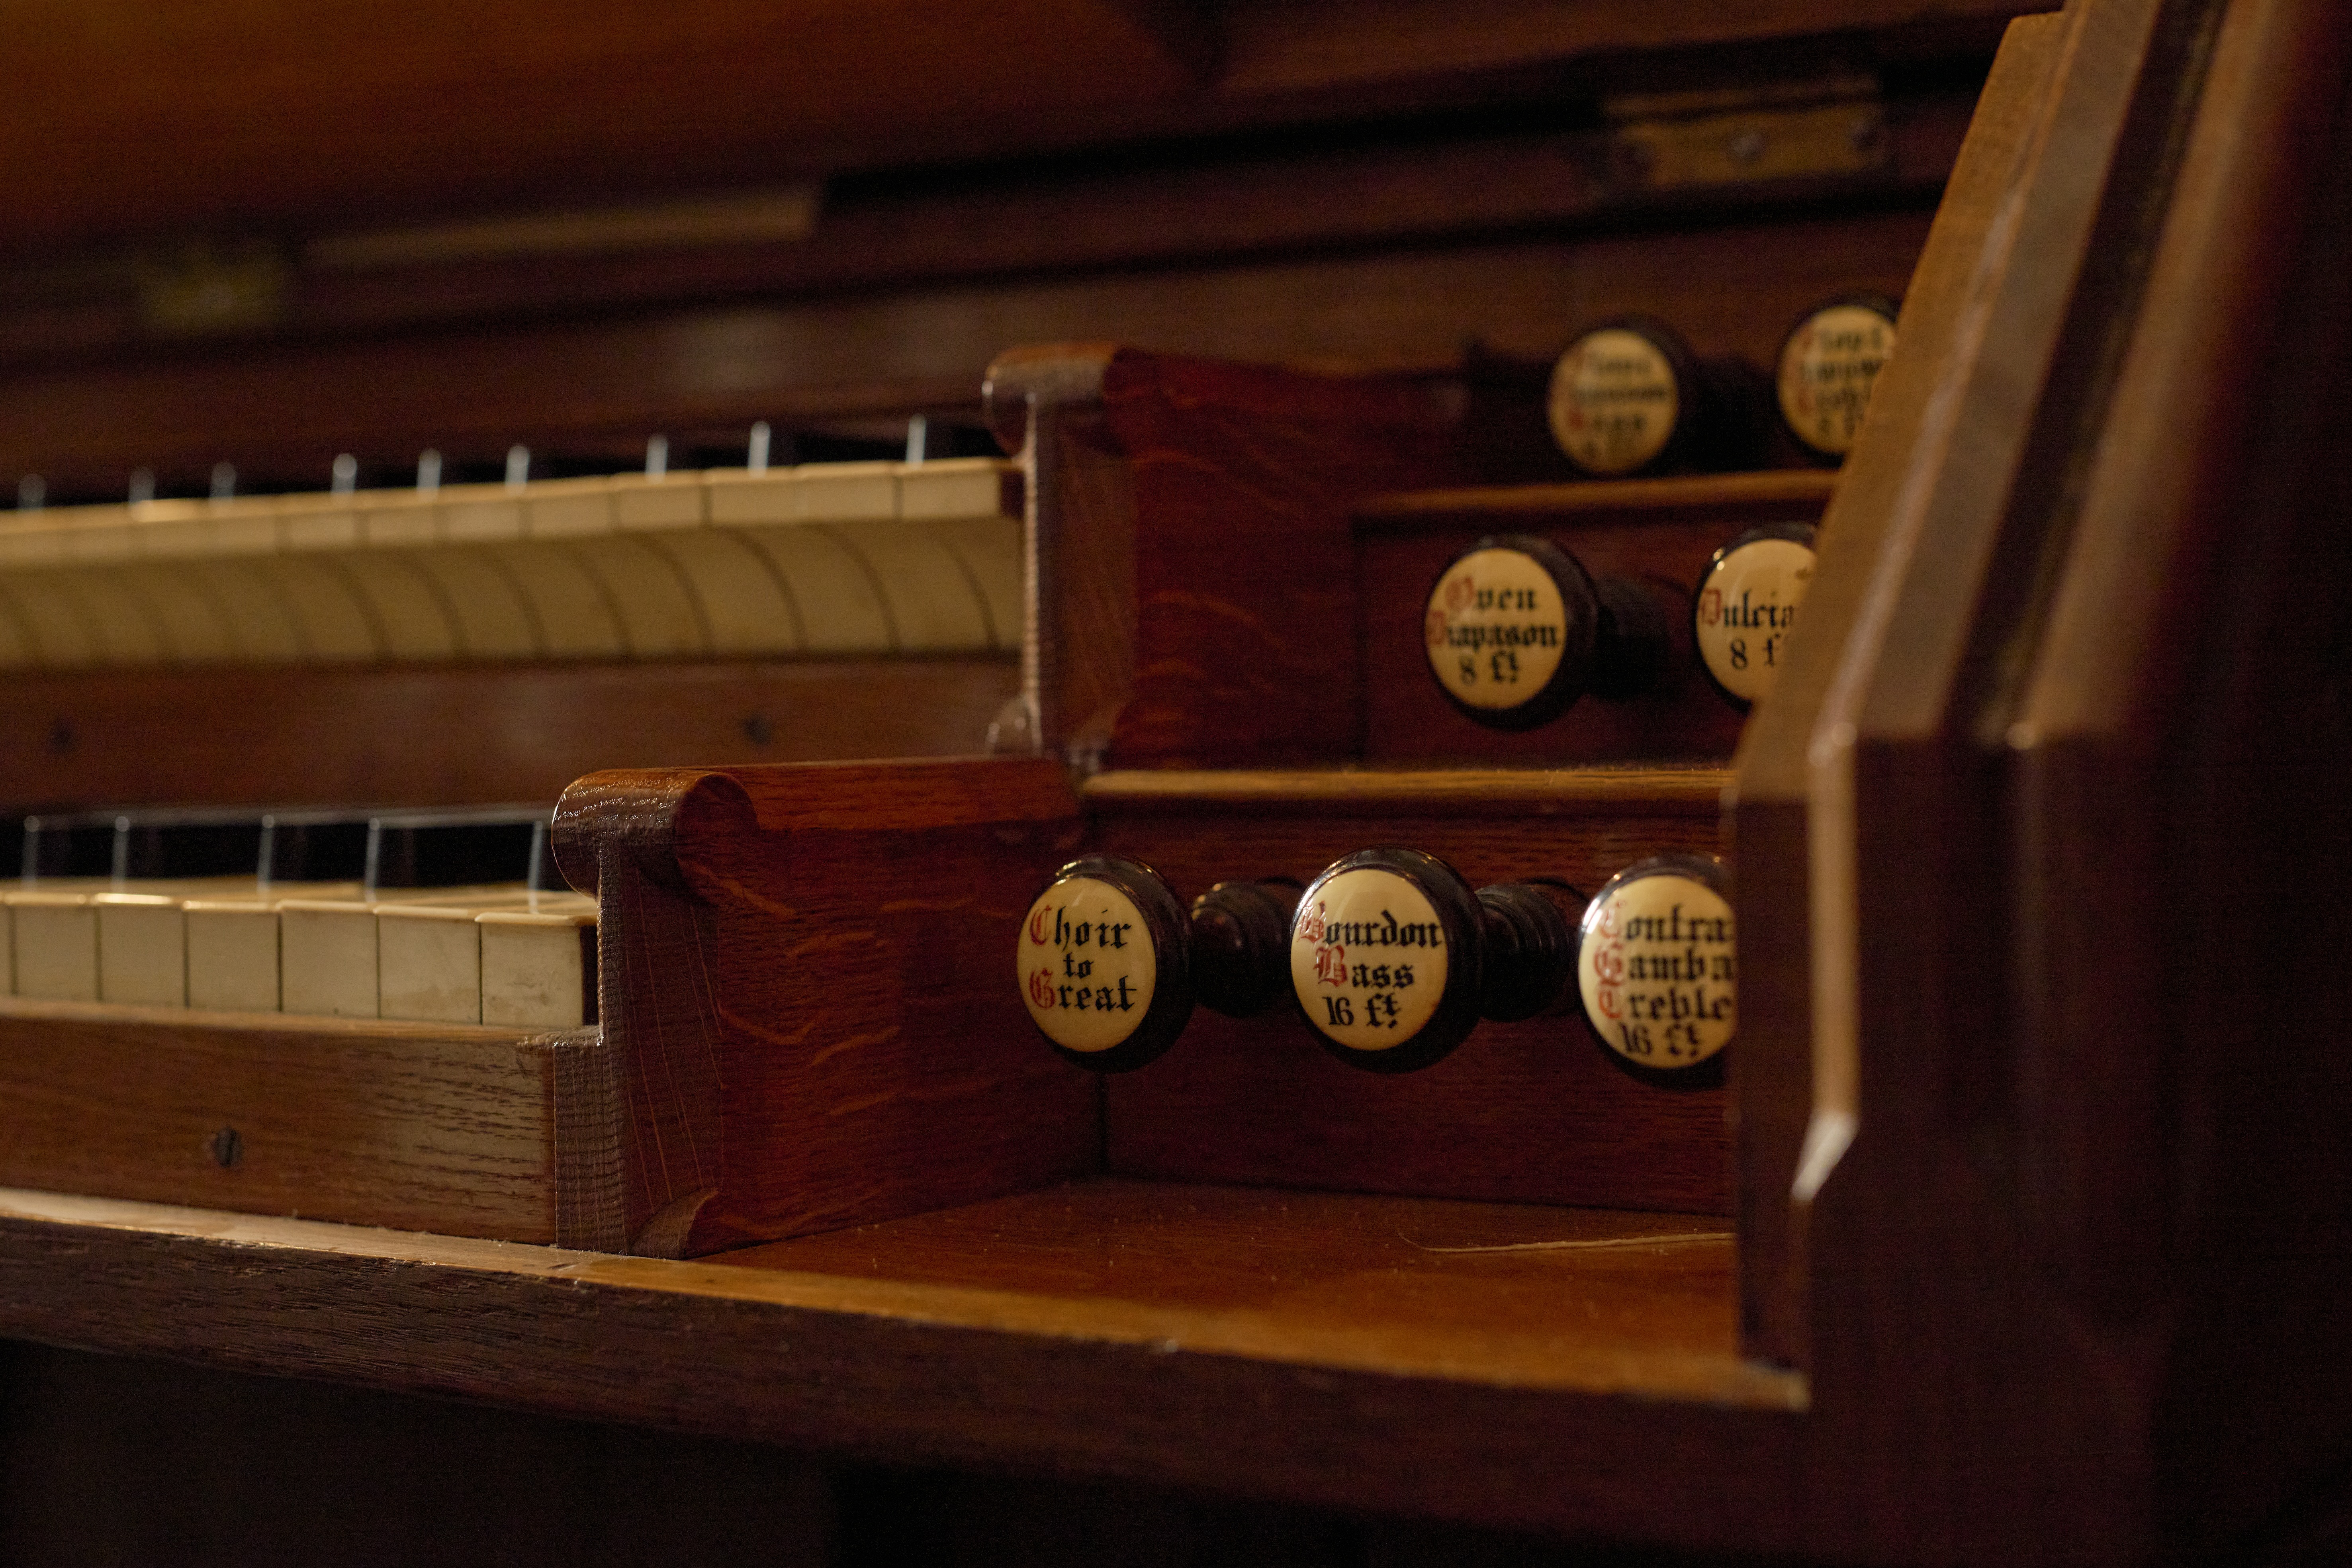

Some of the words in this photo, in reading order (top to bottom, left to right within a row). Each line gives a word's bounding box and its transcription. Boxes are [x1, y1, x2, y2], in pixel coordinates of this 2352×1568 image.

[1700, 588, 1794, 628] Dulcia
[1459, 654, 1477, 686] 8
[1730, 638, 1748, 670] 8
[1763, 633, 1781, 668] f
[1029, 905, 1132, 951] Choir
[1296, 900, 1441, 948] Bourdon
[1063, 952, 1094, 979] to
[1314, 945, 1414, 989] Bass
[1029, 968, 1137, 1012] Great
[1323, 996, 1354, 1026] 16
[1618, 1022, 1653, 1055] 16
